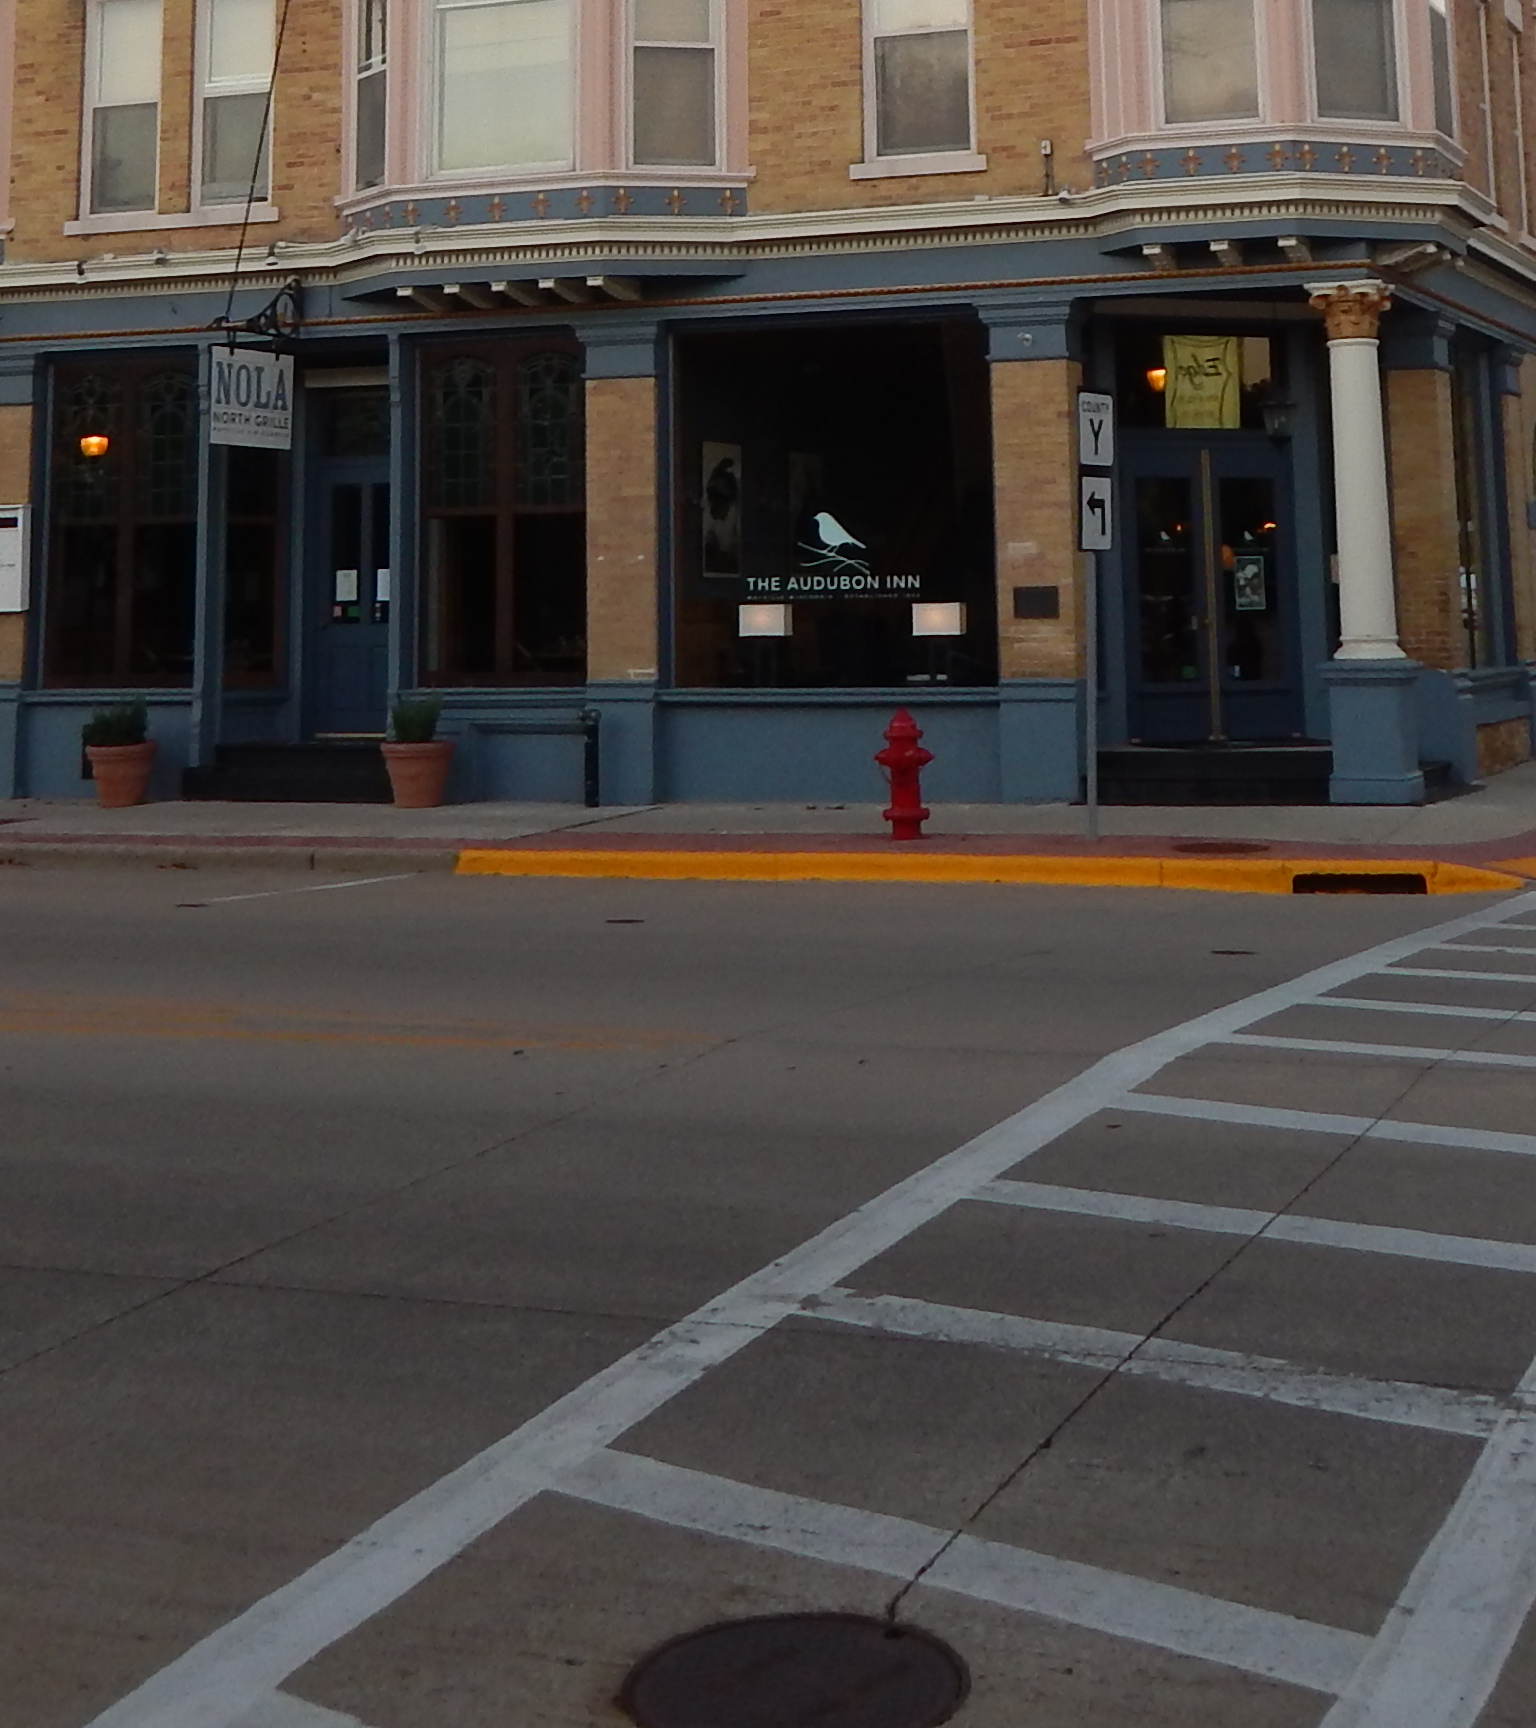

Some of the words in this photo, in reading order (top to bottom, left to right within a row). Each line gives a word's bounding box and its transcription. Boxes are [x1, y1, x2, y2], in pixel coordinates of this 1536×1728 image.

[214, 360, 289, 411] NOLA
[1081, 400, 1110, 413] COUNTY
[212, 411, 251, 425] NORTH
[254, 415, 289, 429] GRILLE
[1089, 417, 1104, 456] Y
[746, 576, 782, 591] THE
[786, 575, 880, 591] AUDUBON
[886, 574, 921, 589] INN
